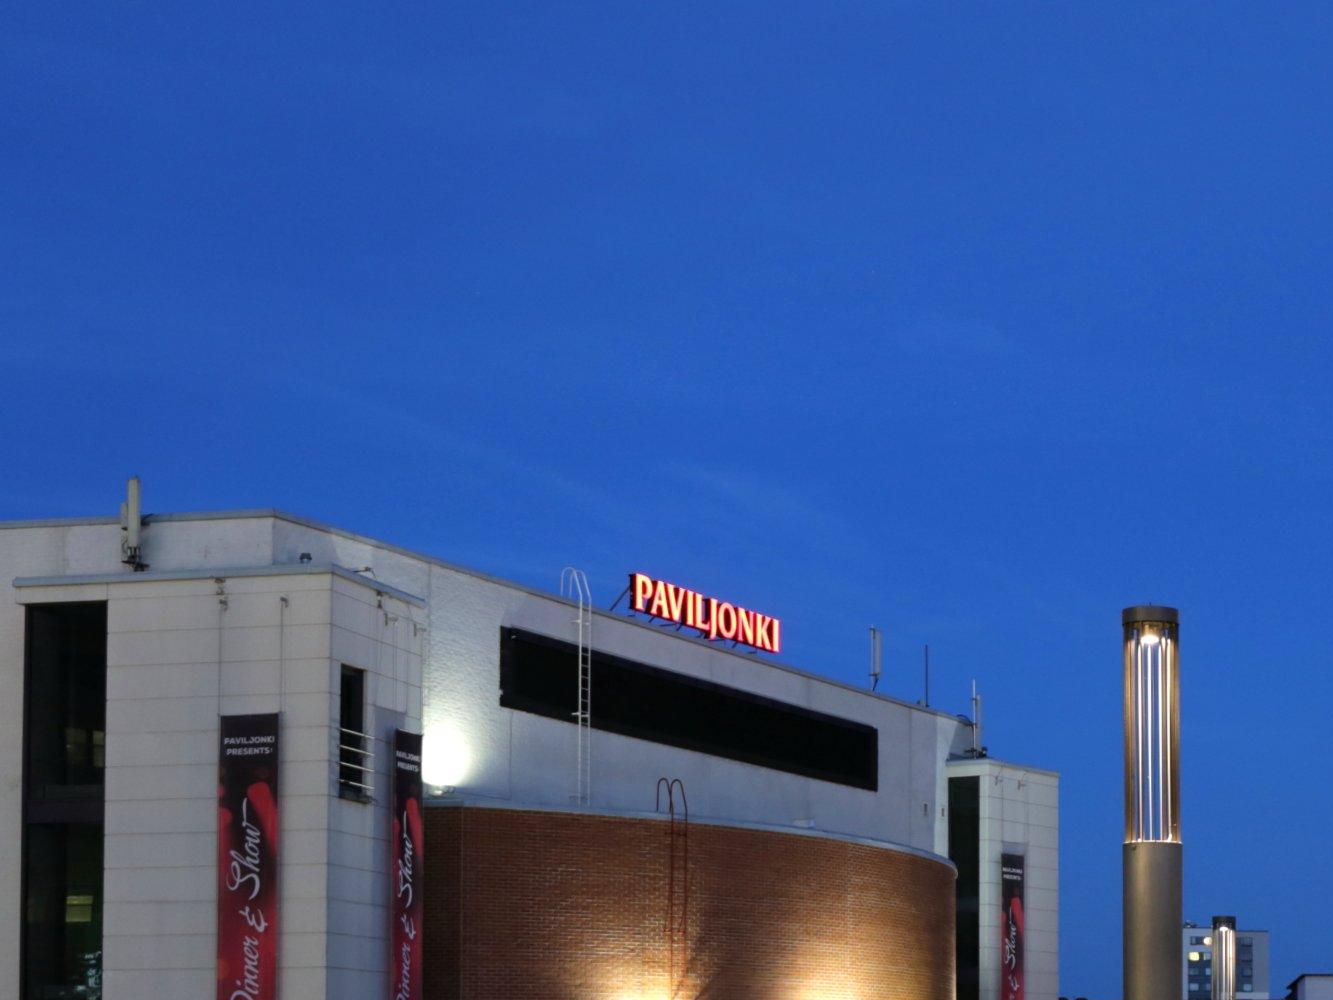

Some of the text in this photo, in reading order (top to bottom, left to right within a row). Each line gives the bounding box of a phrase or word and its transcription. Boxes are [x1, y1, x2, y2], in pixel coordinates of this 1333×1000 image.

[634, 572, 781, 654] PAVILJONKI
[224, 735, 275, 745] PAVILJONKI
[225, 797, 261, 900] Show
[397, 811, 415, 908] Show
[238, 904, 268, 934] &
[400, 912, 417, 940] &
[1004, 905, 1017, 971] Show
